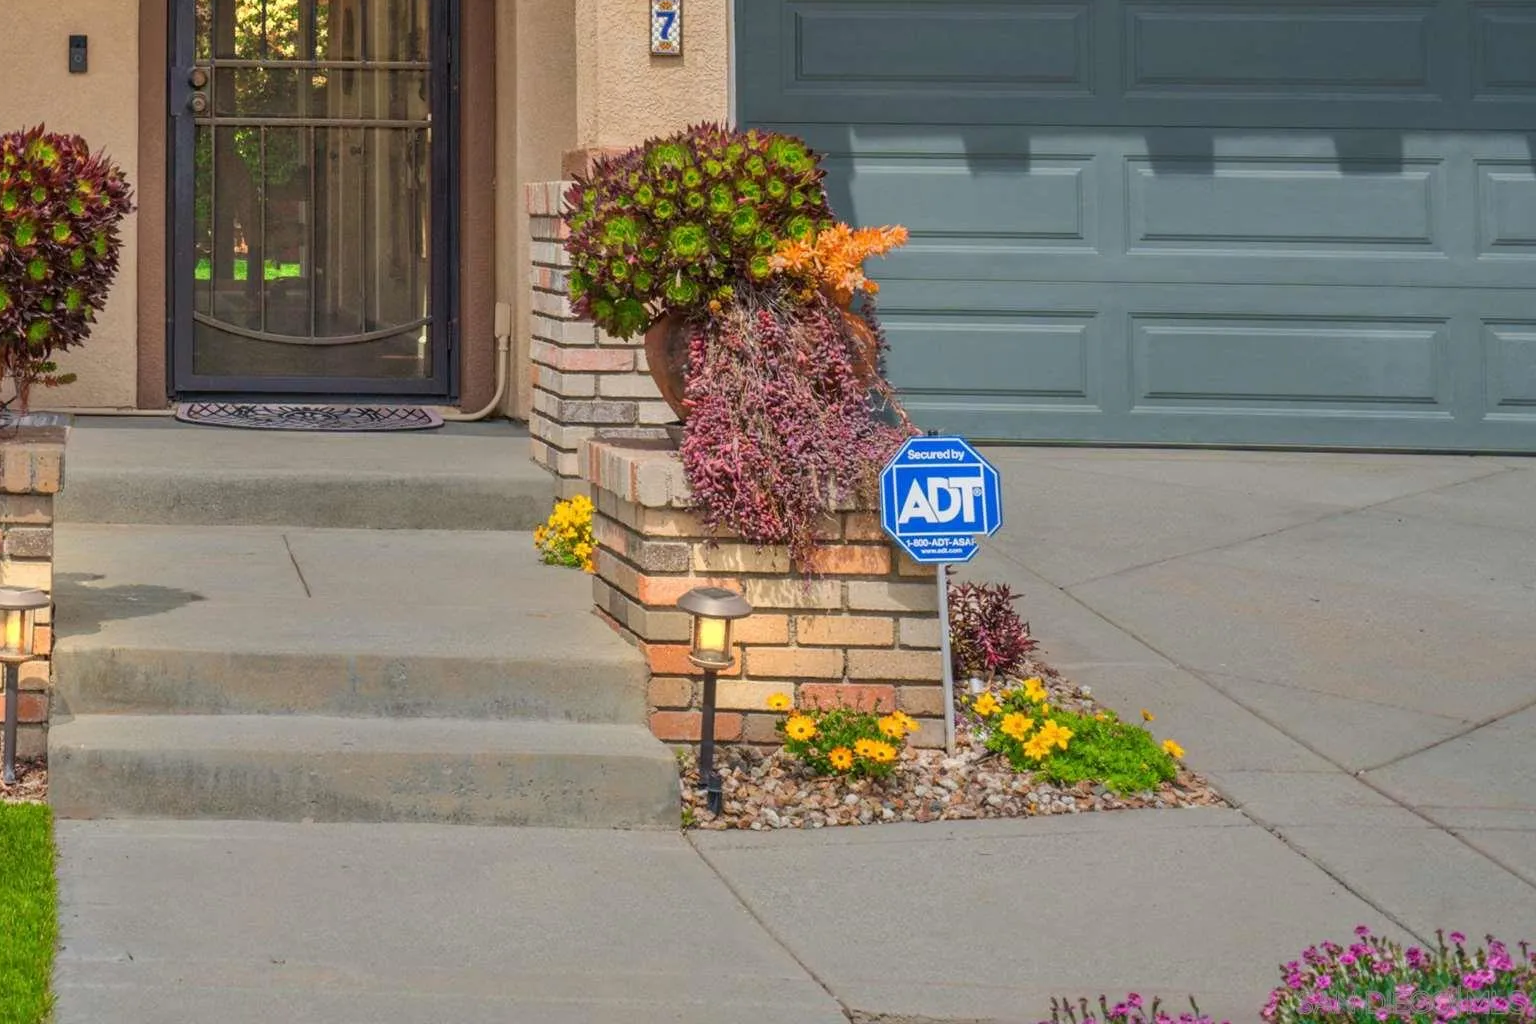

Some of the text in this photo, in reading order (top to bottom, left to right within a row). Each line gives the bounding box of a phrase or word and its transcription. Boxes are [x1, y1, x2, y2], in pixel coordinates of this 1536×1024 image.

[907, 448, 965, 462] Secured by
[898, 476, 983, 523] ADT
